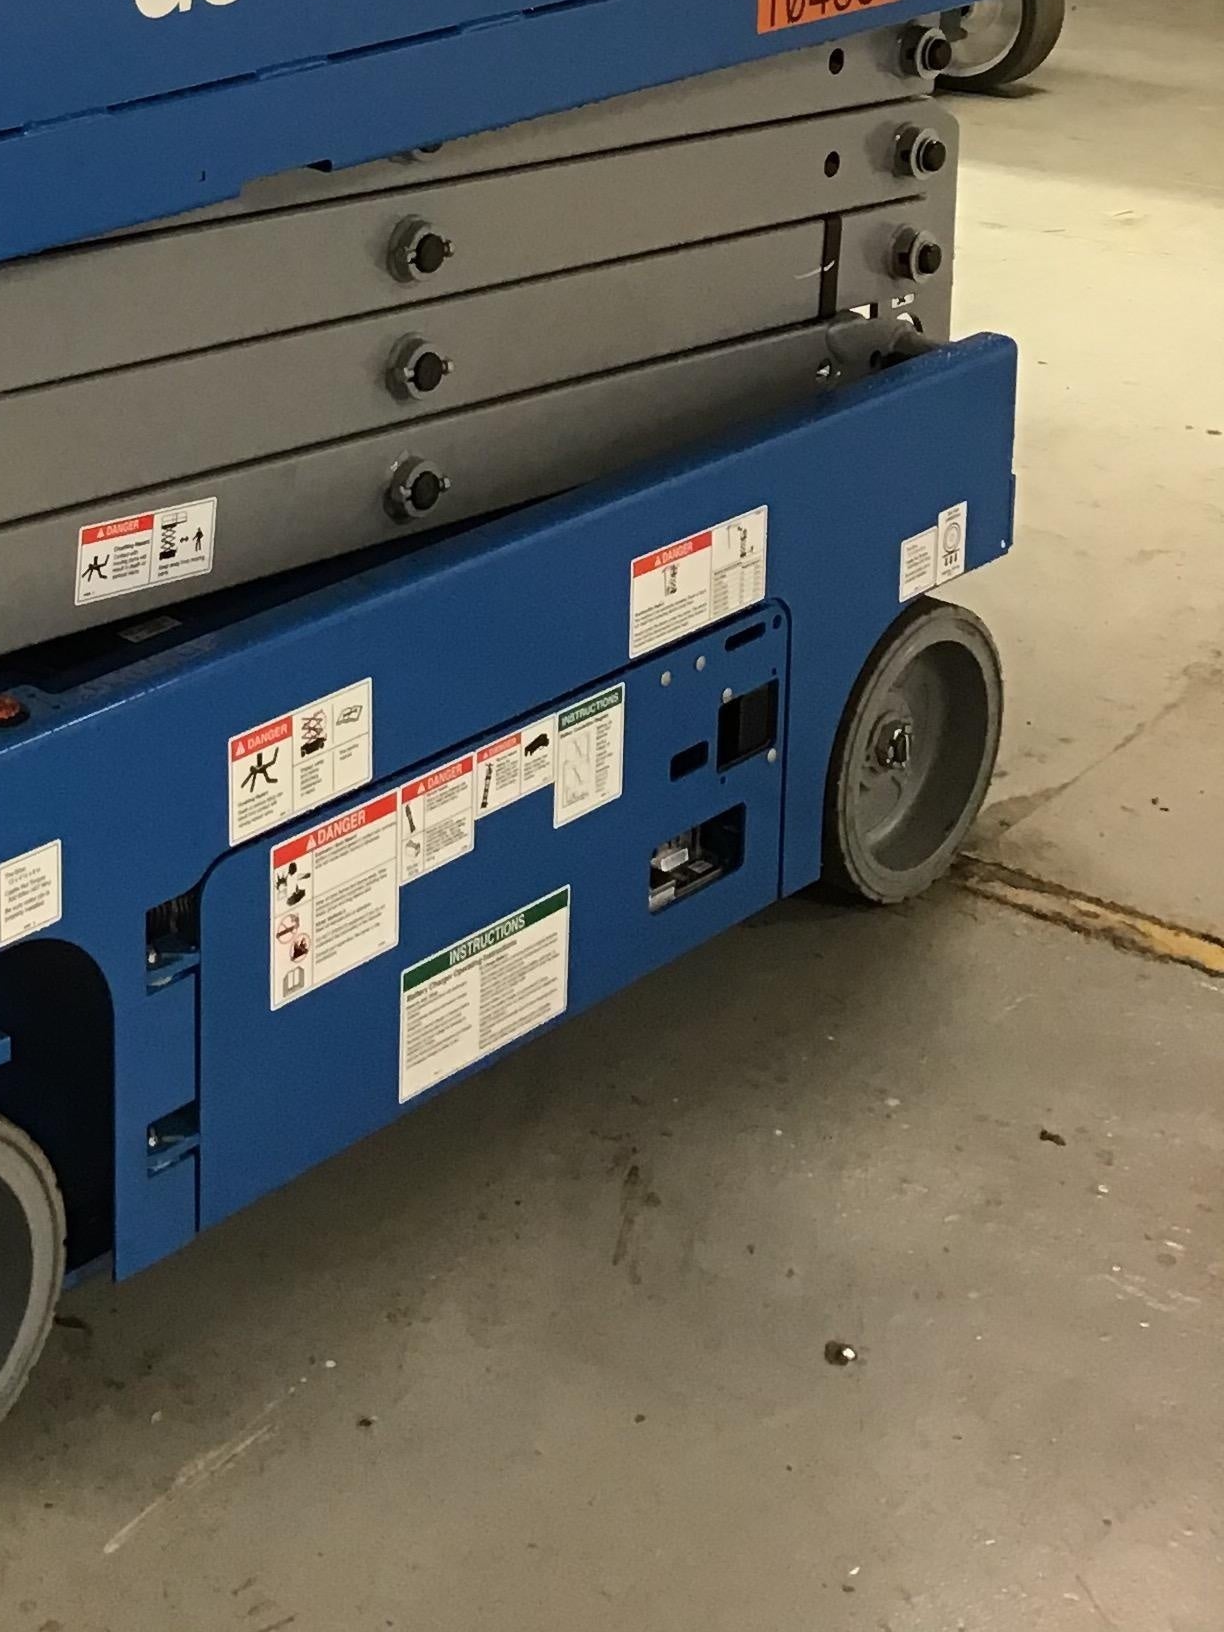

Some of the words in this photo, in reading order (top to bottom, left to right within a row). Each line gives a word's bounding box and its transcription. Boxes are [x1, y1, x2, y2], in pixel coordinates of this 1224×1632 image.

[106, 519, 139, 536] DANGER
[247, 723, 288, 750] DANGER
[427, 763, 463, 790] DANGER
[317, 809, 366, 845] DANGER
[449, 913, 526, 965] INSTRUCTIONS
